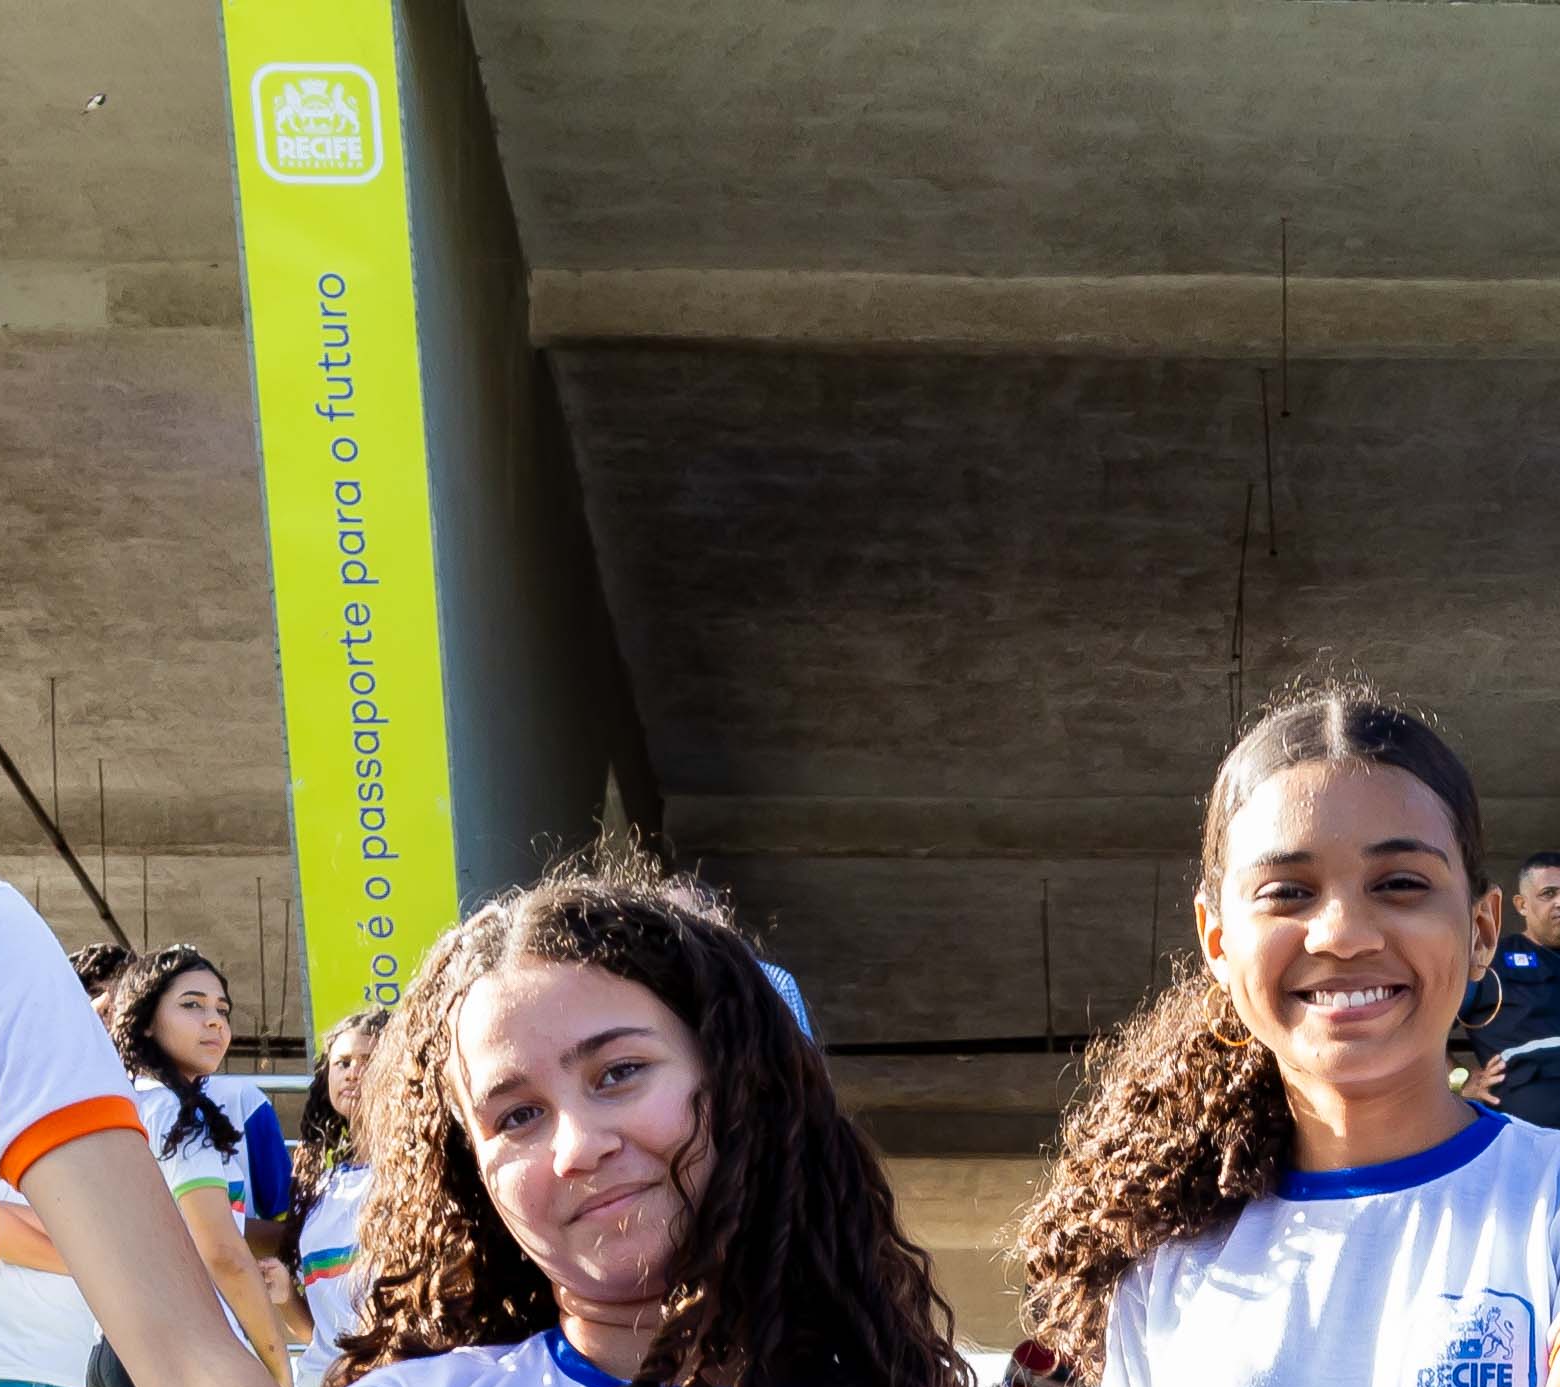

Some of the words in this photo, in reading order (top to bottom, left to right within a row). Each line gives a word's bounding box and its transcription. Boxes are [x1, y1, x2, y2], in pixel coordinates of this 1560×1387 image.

[276, 136, 363, 160] RECIFE
[314, 272, 356, 423] futuro
[330, 437, 359, 463] o
[334, 480, 380, 586] para
[340, 602, 399, 859] passaporte
[364, 876, 392, 901] o
[357, 914, 395, 938] é
